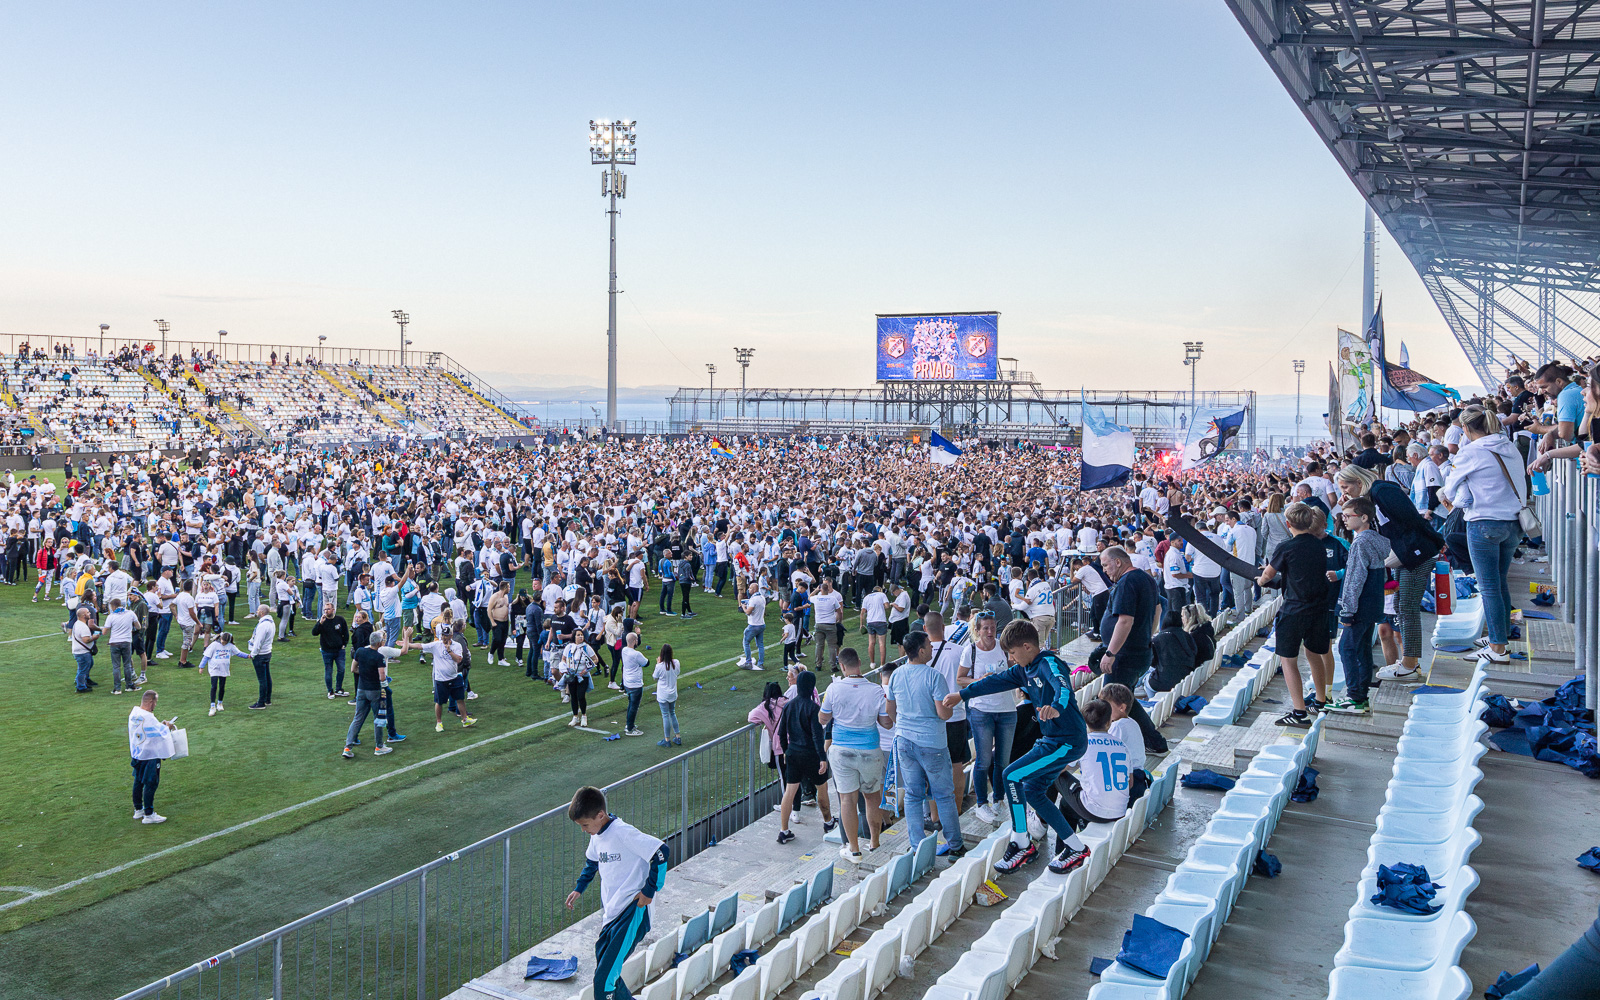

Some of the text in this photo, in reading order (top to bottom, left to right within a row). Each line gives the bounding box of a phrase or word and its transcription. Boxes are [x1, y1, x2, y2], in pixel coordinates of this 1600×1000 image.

[913, 361, 955, 378] PRVACI
[1037, 590, 1053, 605] 26
[1096, 751, 1129, 792] 16
